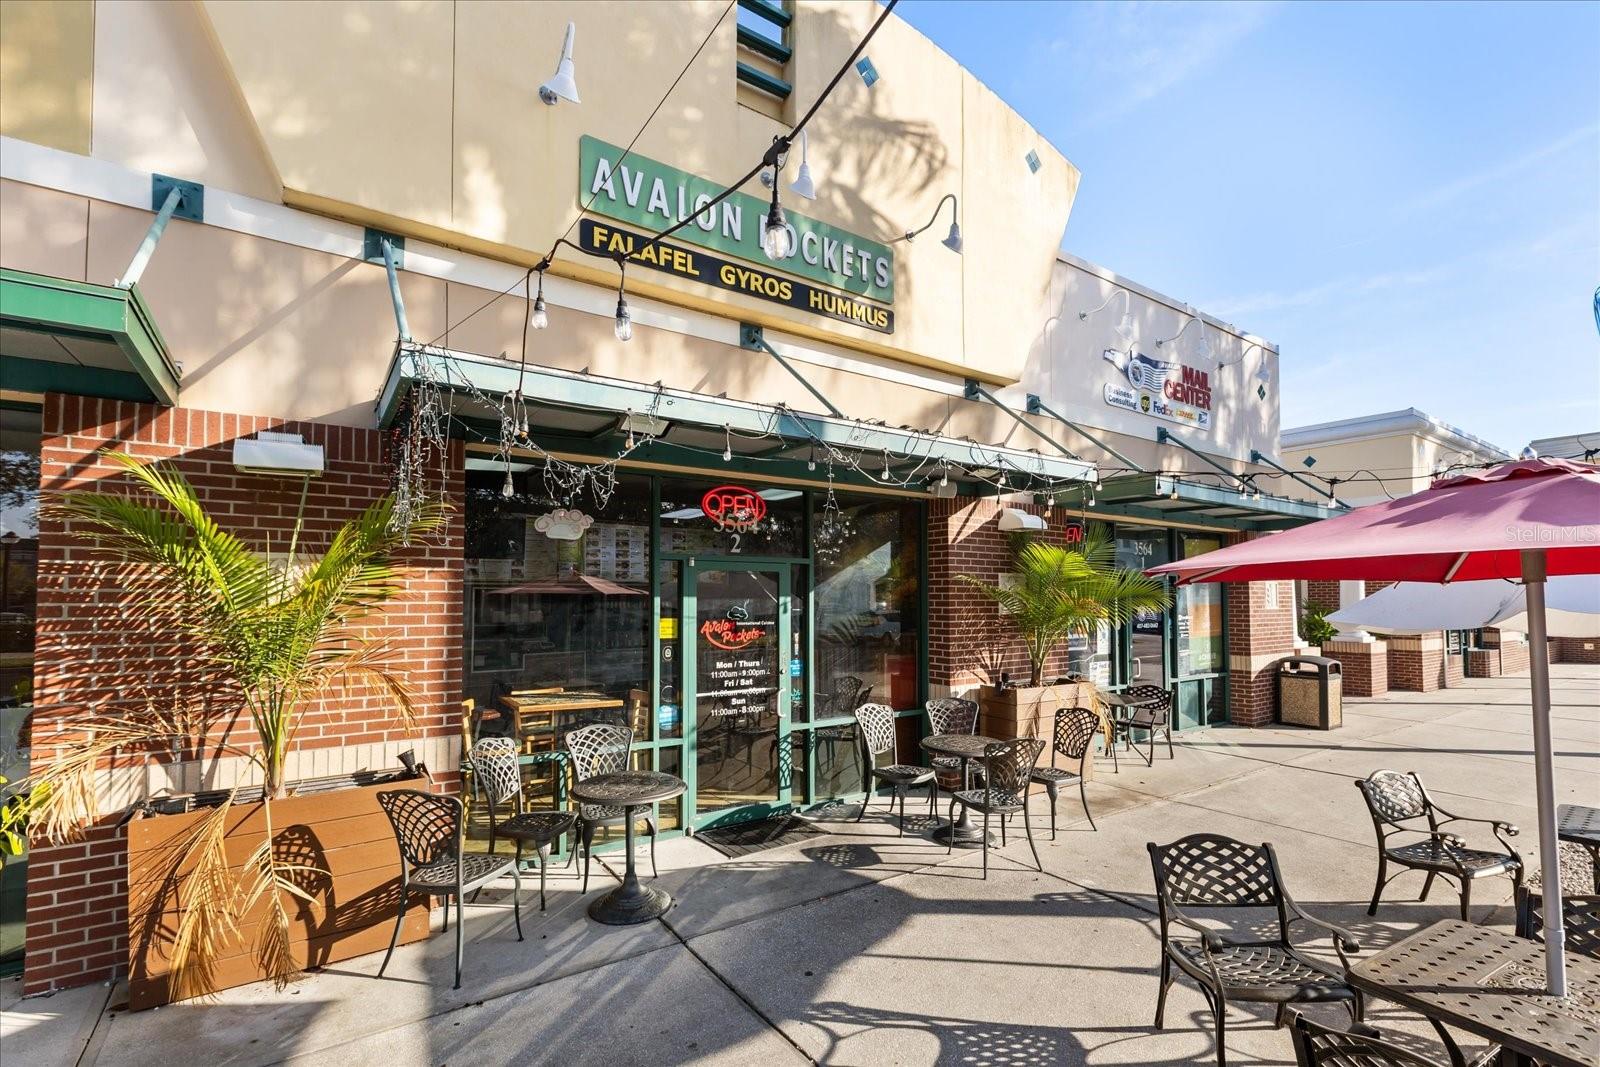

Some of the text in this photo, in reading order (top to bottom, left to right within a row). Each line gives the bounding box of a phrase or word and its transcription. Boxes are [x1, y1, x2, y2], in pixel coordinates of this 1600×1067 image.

[591, 157, 742, 243] AVALON
[593, 226, 889, 328] FALAFEL GYROS HUMMUS
[1164, 379, 1211, 411] CENTER
[1153, 400, 1174, 417] FedEx
[705, 494, 759, 518] OPEN
[730, 533, 742, 553] 2
[1066, 527, 1082, 544] EN
[1134, 541, 1153, 556] 3564
[716, 661, 733, 669] Mon
[738, 660, 760, 668] Thurs
[711, 671, 738, 679] 11:00am
[740, 678, 753, 686] Sat
[711, 708, 738, 717] 11:00am
